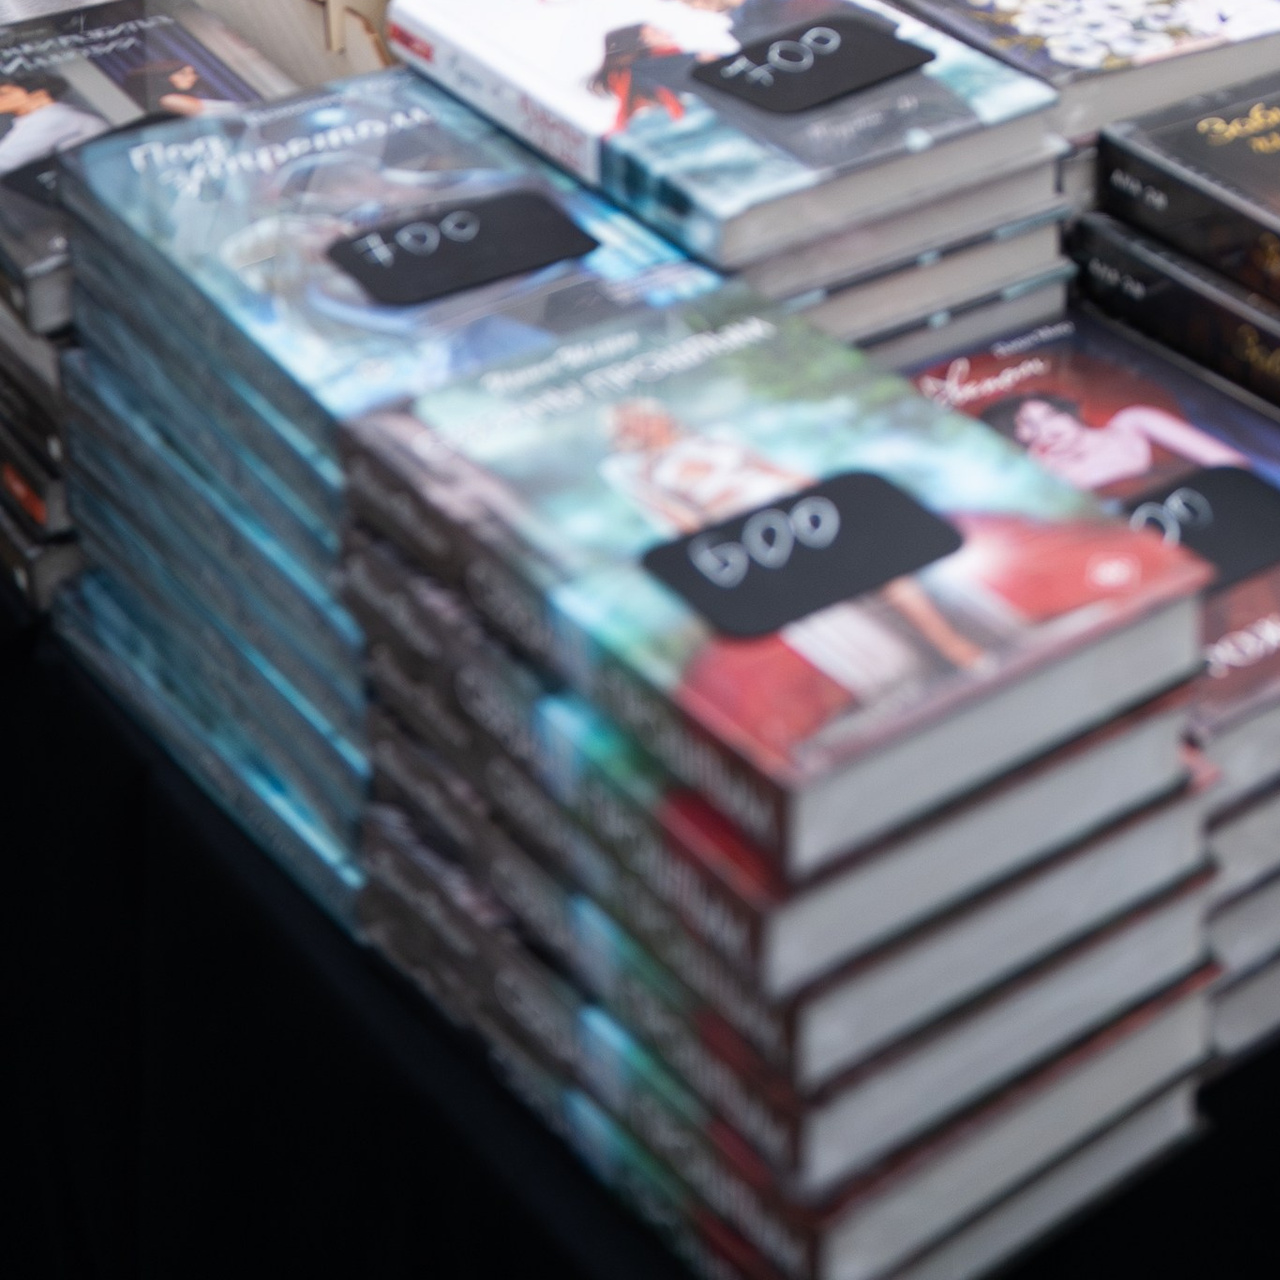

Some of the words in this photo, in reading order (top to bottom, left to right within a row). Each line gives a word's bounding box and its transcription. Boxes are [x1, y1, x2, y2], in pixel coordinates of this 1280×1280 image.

[719, 26, 842, 88] 700
[352, 210, 482, 270] 700
[687, 494, 841, 590] 600
